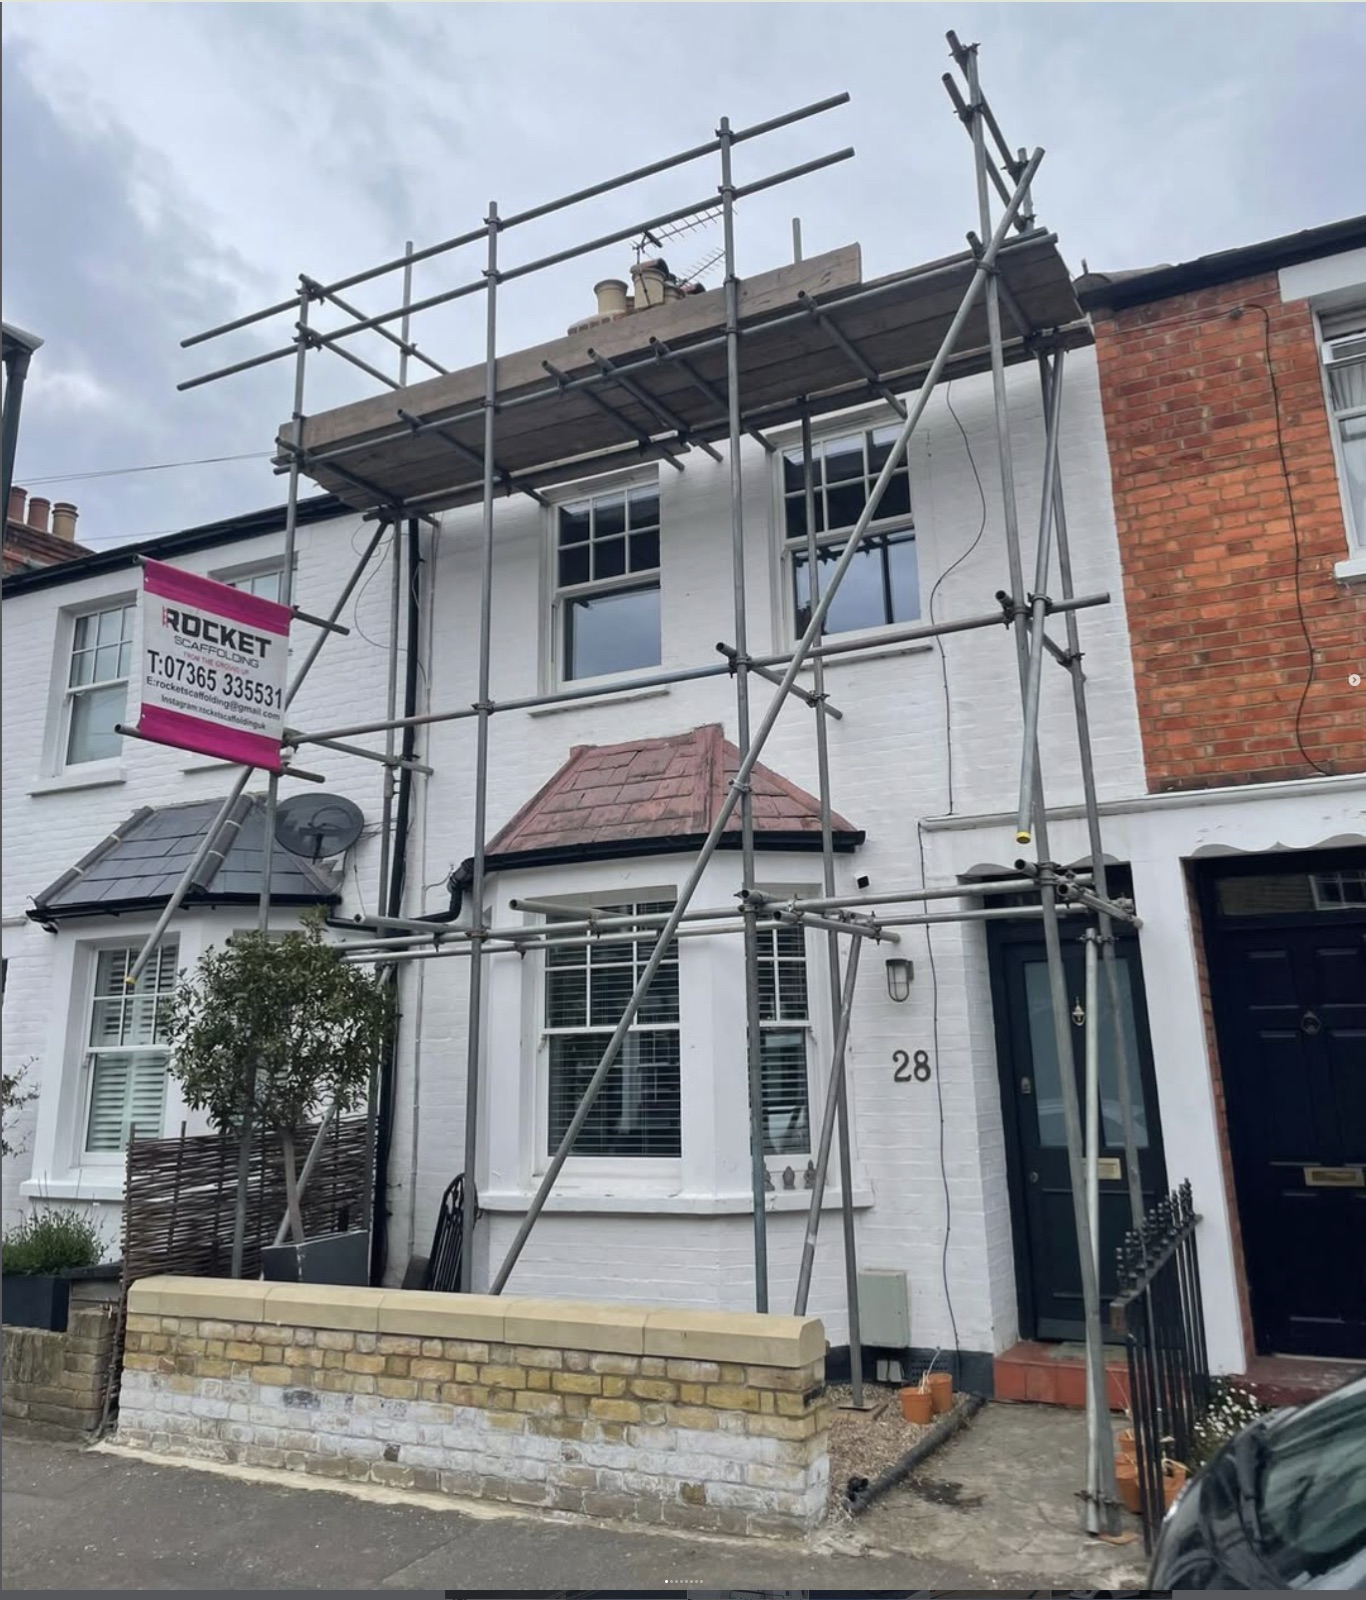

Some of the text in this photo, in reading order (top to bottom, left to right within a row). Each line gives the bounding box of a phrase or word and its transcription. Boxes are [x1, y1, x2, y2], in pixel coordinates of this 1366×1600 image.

[162, 606, 272, 658] ROCKET
[174, 635, 260, 669] SCAFFOLDING
[146, 676, 280, 721] E:rocketscaffolding@gmail.com
[147, 649, 282, 710] T:07365 335531
[892, 1049, 931, 1083] 28
